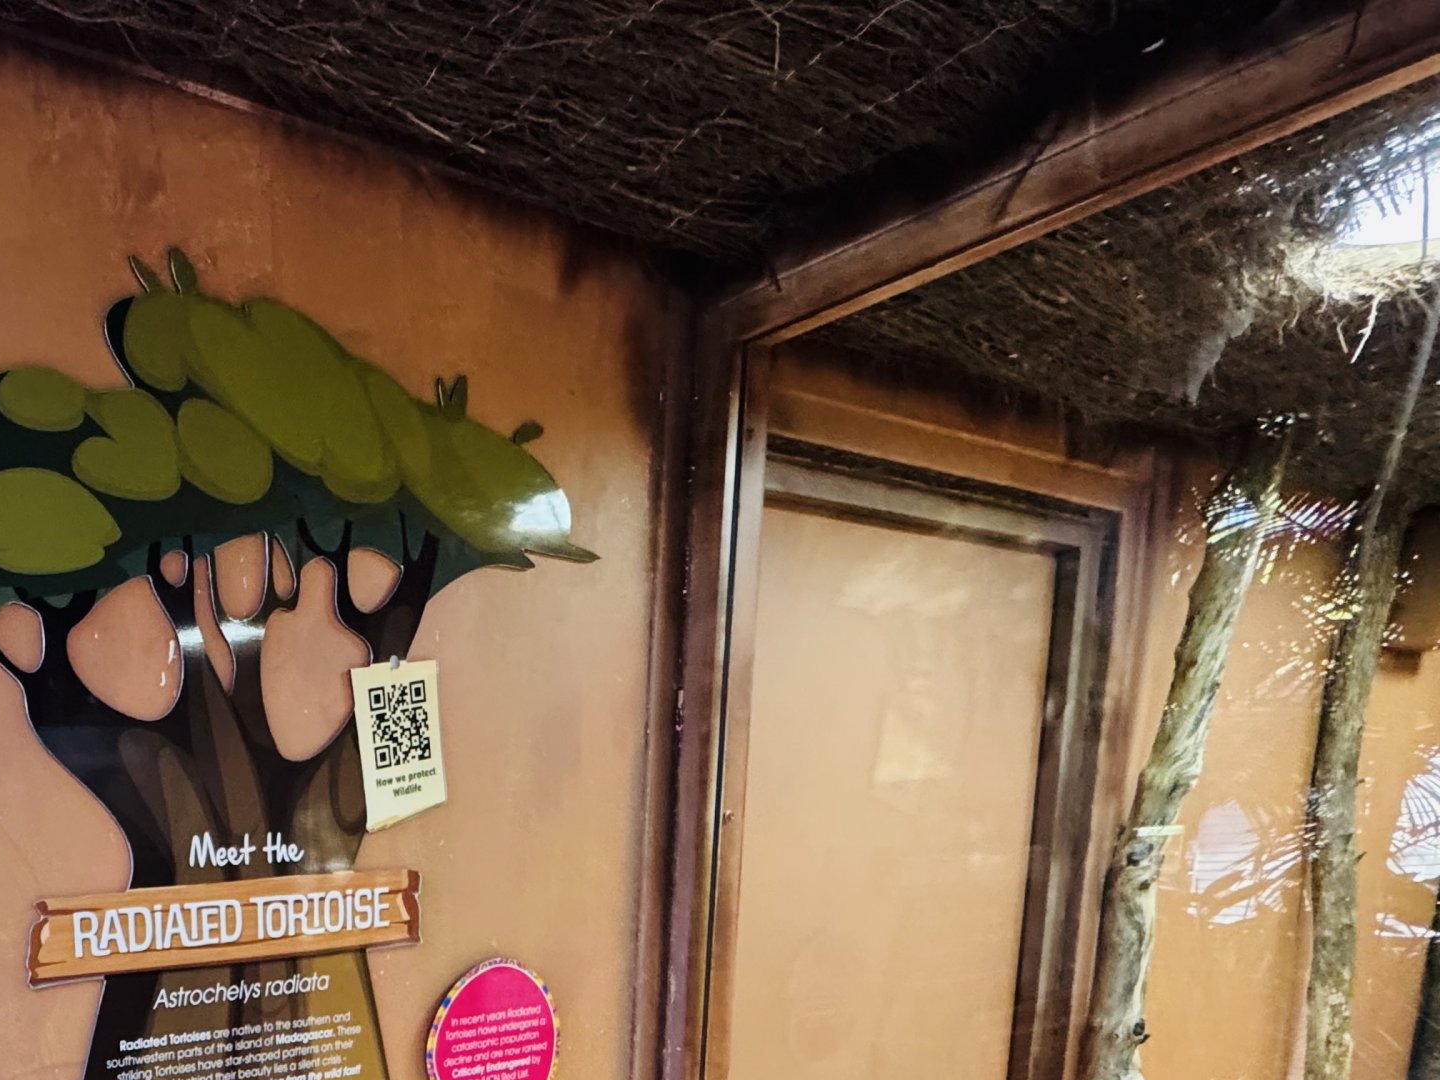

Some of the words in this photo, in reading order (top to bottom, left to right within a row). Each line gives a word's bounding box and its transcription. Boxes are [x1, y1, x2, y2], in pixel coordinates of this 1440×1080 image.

[376, 776, 393, 788] How
[409, 767, 436, 782] protect
[393, 785, 422, 798] Wildlife
[189, 832, 256, 868] Meet
[262, 832, 305, 864] the
[73, 899, 242, 957] RADIATED
[250, 887, 390, 939] TORTOISE
[154, 982, 260, 1010] Astrochelys
[265, 973, 329, 997] radiata
[106, 1051, 175, 1069] southwestern
[177, 1046, 202, 1062] parts
[204, 1043, 214, 1056] of
[216, 1042, 232, 1054] the
[234, 1037, 262, 1052] island
[264, 1035, 274, 1047] of
[337, 1025, 361, 1037] These
[119, 1035, 167, 1052] Radiated
[169, 1031, 211, 1045] Tortoises
[213, 1030, 229, 1040] are
[231, 1024, 261, 1037] native
[263, 1022, 273, 1033] to
[275, 1020, 290, 1032] the
[292, 1016, 330, 1029] southern
[332, 1011, 350, 1024] and
[154, 1063, 195, 1078] Tortoises
[197, 1060, 223, 1072] have
[225, 1050, 279, 1068] star-shaped
[282, 1047, 318, 1063] patterns
[320, 1045, 332, 1054] on
[334, 1040, 353, 1053] their
[238, 1065, 271, 1080] beauty
[273, 1063, 288, 1075] lies
[290, 1064, 296, 1073] a
[298, 1057, 319, 1071] silent
[321, 1055, 341, 1068] crisis
[323, 1067, 341, 1080] wild
